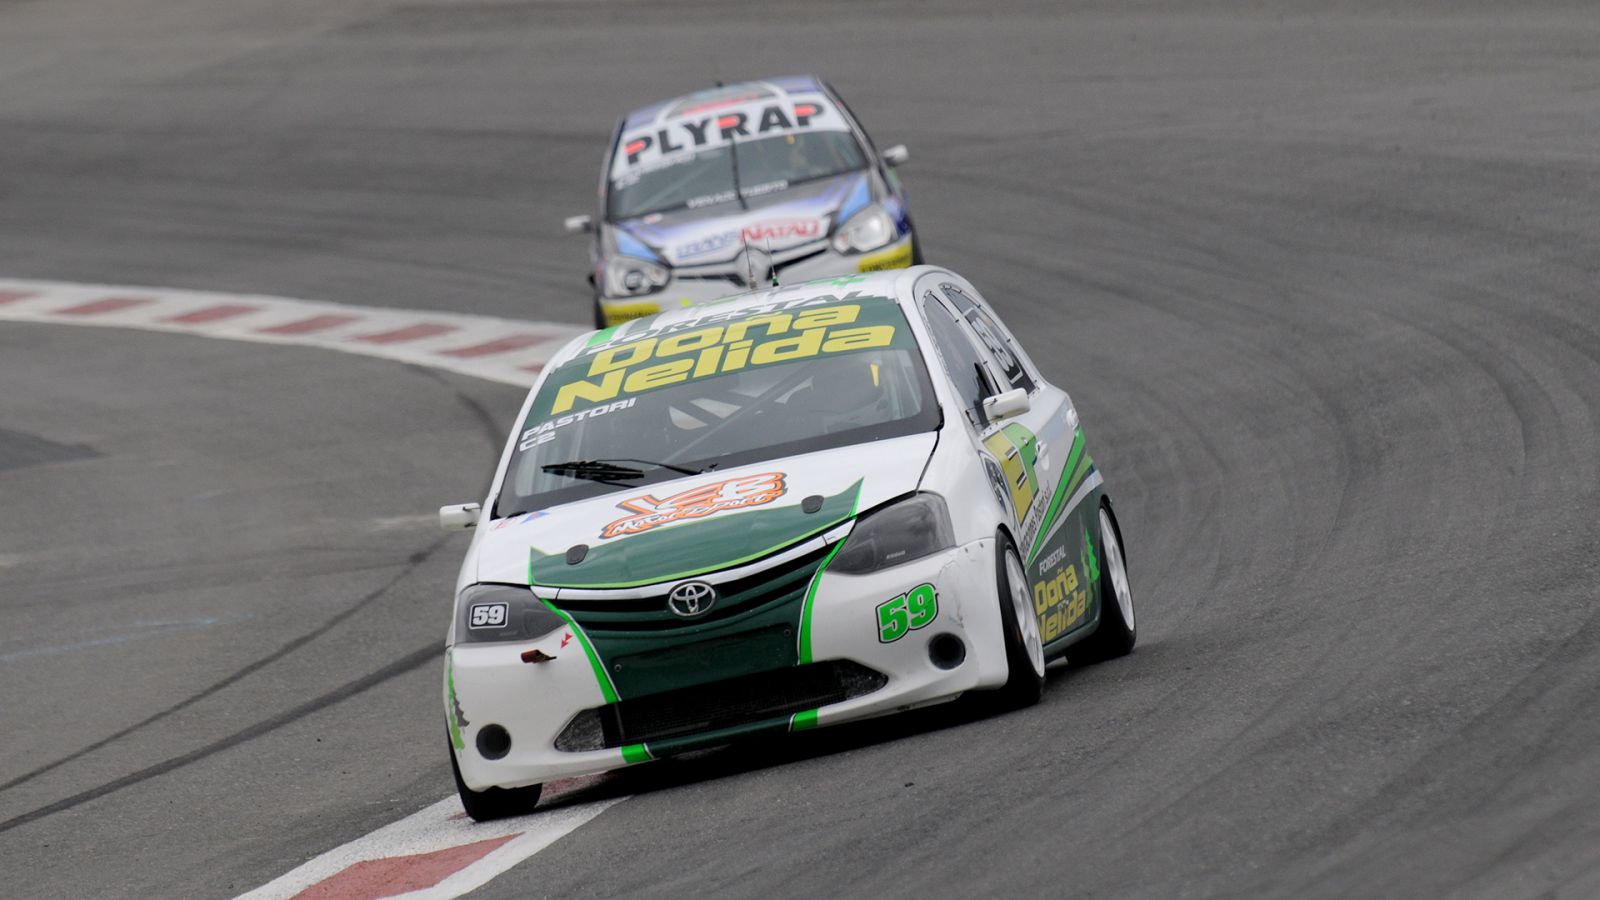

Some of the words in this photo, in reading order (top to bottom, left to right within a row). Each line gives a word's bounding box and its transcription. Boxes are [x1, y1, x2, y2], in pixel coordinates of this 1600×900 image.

[624, 102, 825, 165] PLYRAP
[587, 305, 861, 377] Doña
[551, 325, 896, 416] Nelida
[519, 431, 556, 452] C2
[522, 398, 637, 441] PASTORI
[472, 605, 505, 626] 59
[877, 584, 938, 643] 59
[1034, 564, 1079, 616] Doña
